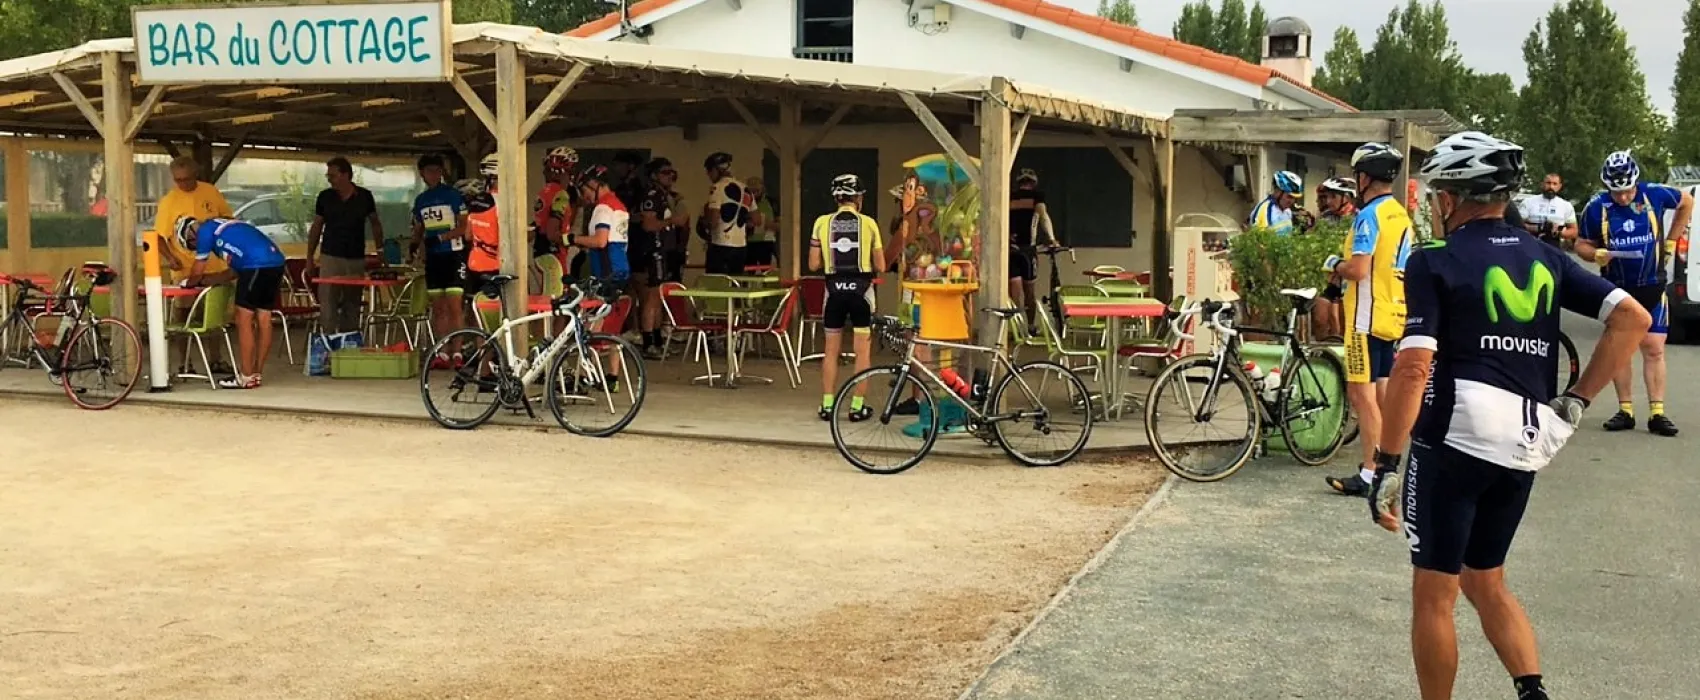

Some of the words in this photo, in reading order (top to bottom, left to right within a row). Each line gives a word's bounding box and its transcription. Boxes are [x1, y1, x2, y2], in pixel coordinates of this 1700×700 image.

[148, 23, 219, 66] BAR
[229, 23, 260, 66] du
[268, 16, 430, 65] COTTAGE
[835, 282, 857, 290] VLC
[1480, 334, 1551, 358] movistar
[1406, 453, 1419, 521] movistar
